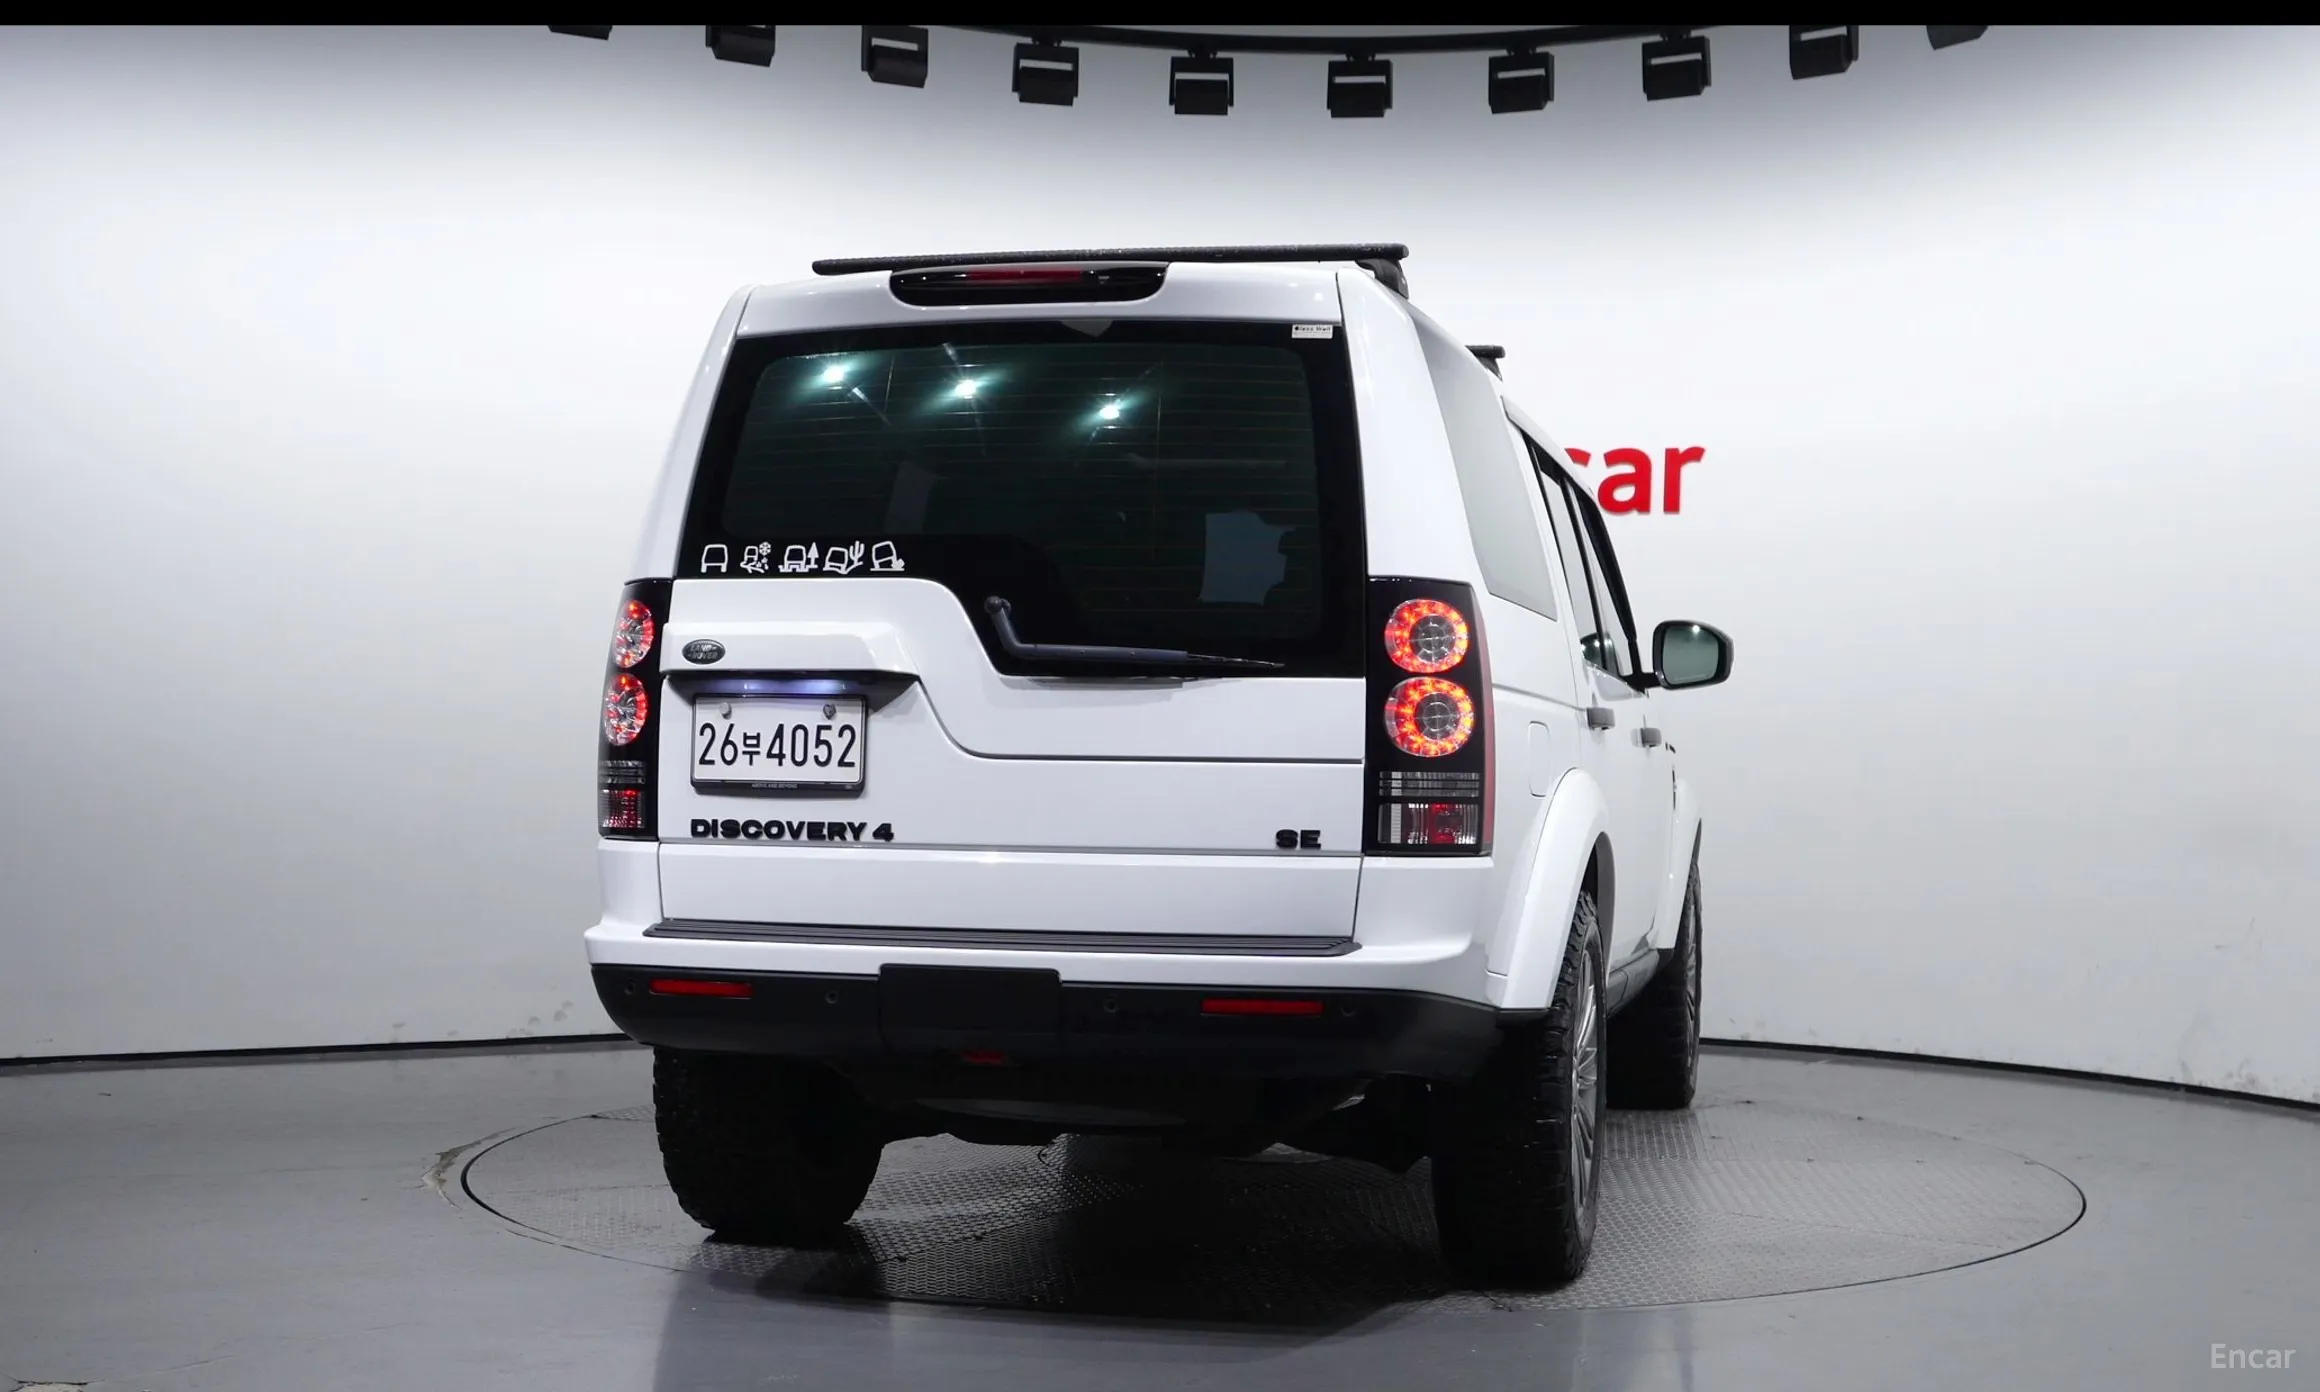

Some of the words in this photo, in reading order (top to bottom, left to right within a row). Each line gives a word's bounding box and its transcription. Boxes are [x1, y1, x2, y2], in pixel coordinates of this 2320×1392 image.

[698, 722, 857, 768] 26부4052
[690, 818, 867, 842] DISCOVERY
[871, 822, 895, 842] 4
[1275, 828, 1321, 850] SE
